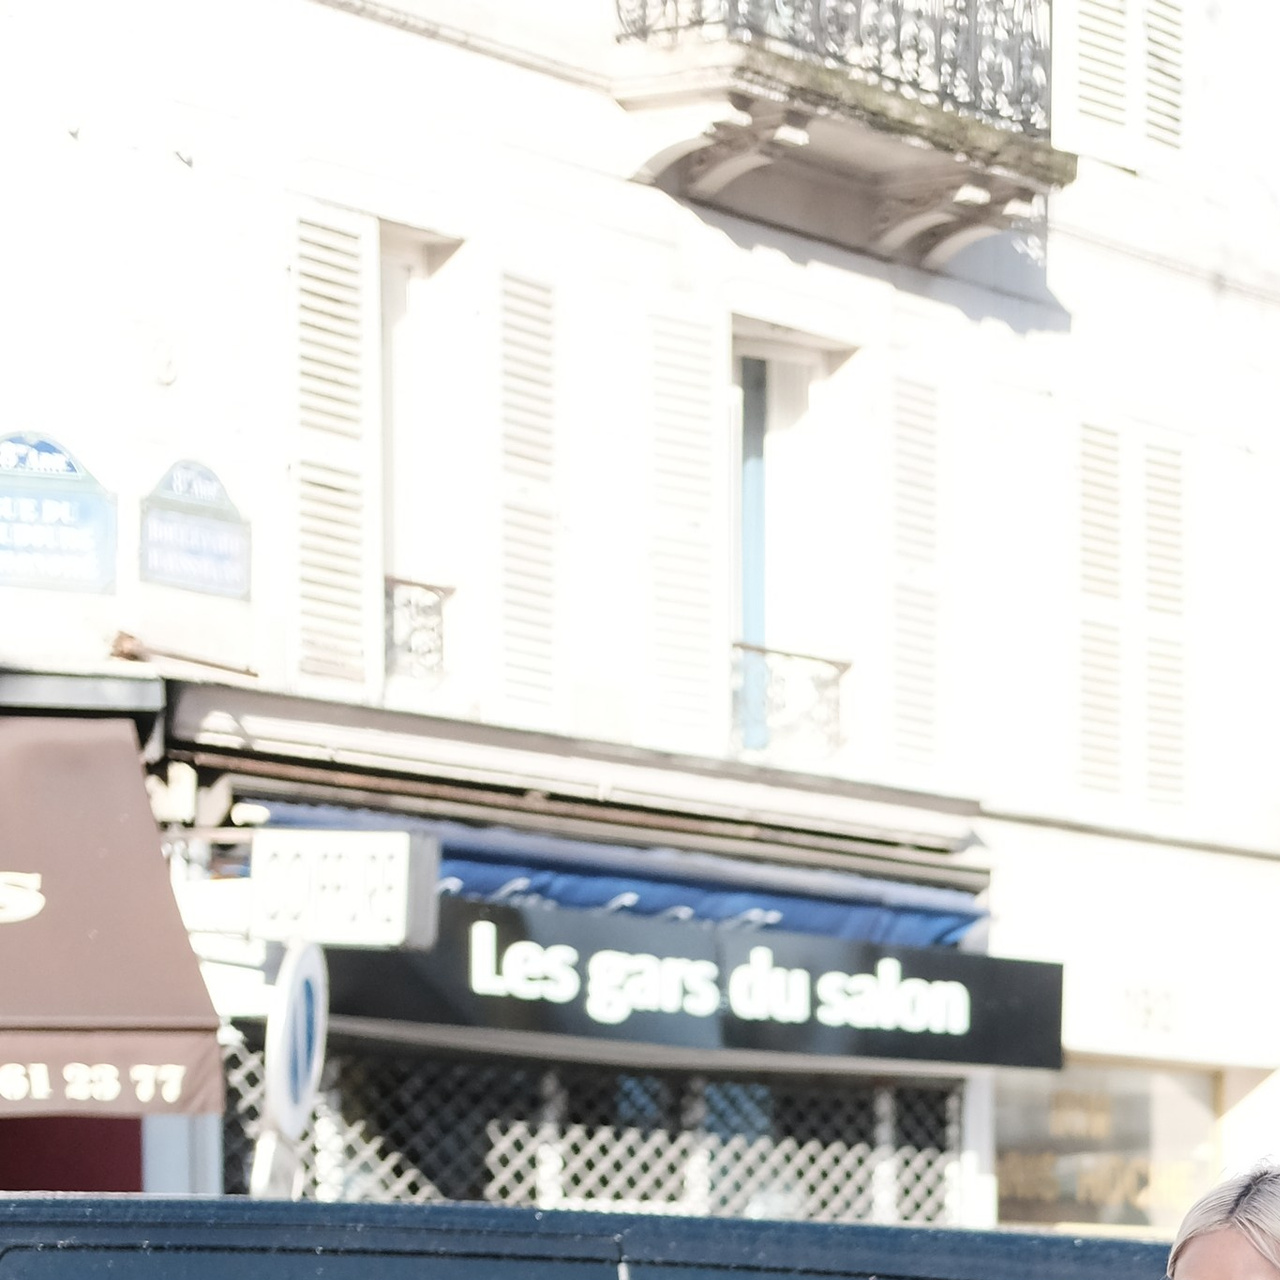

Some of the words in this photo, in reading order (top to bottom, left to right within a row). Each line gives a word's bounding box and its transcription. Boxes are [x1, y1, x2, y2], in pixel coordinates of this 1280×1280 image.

[470, 919, 582, 1004] Les
[584, 947, 722, 1025] gars
[726, 944, 811, 1024] du
[815, 956, 971, 1035] salon
[129, 1063, 187, 1103] 77
